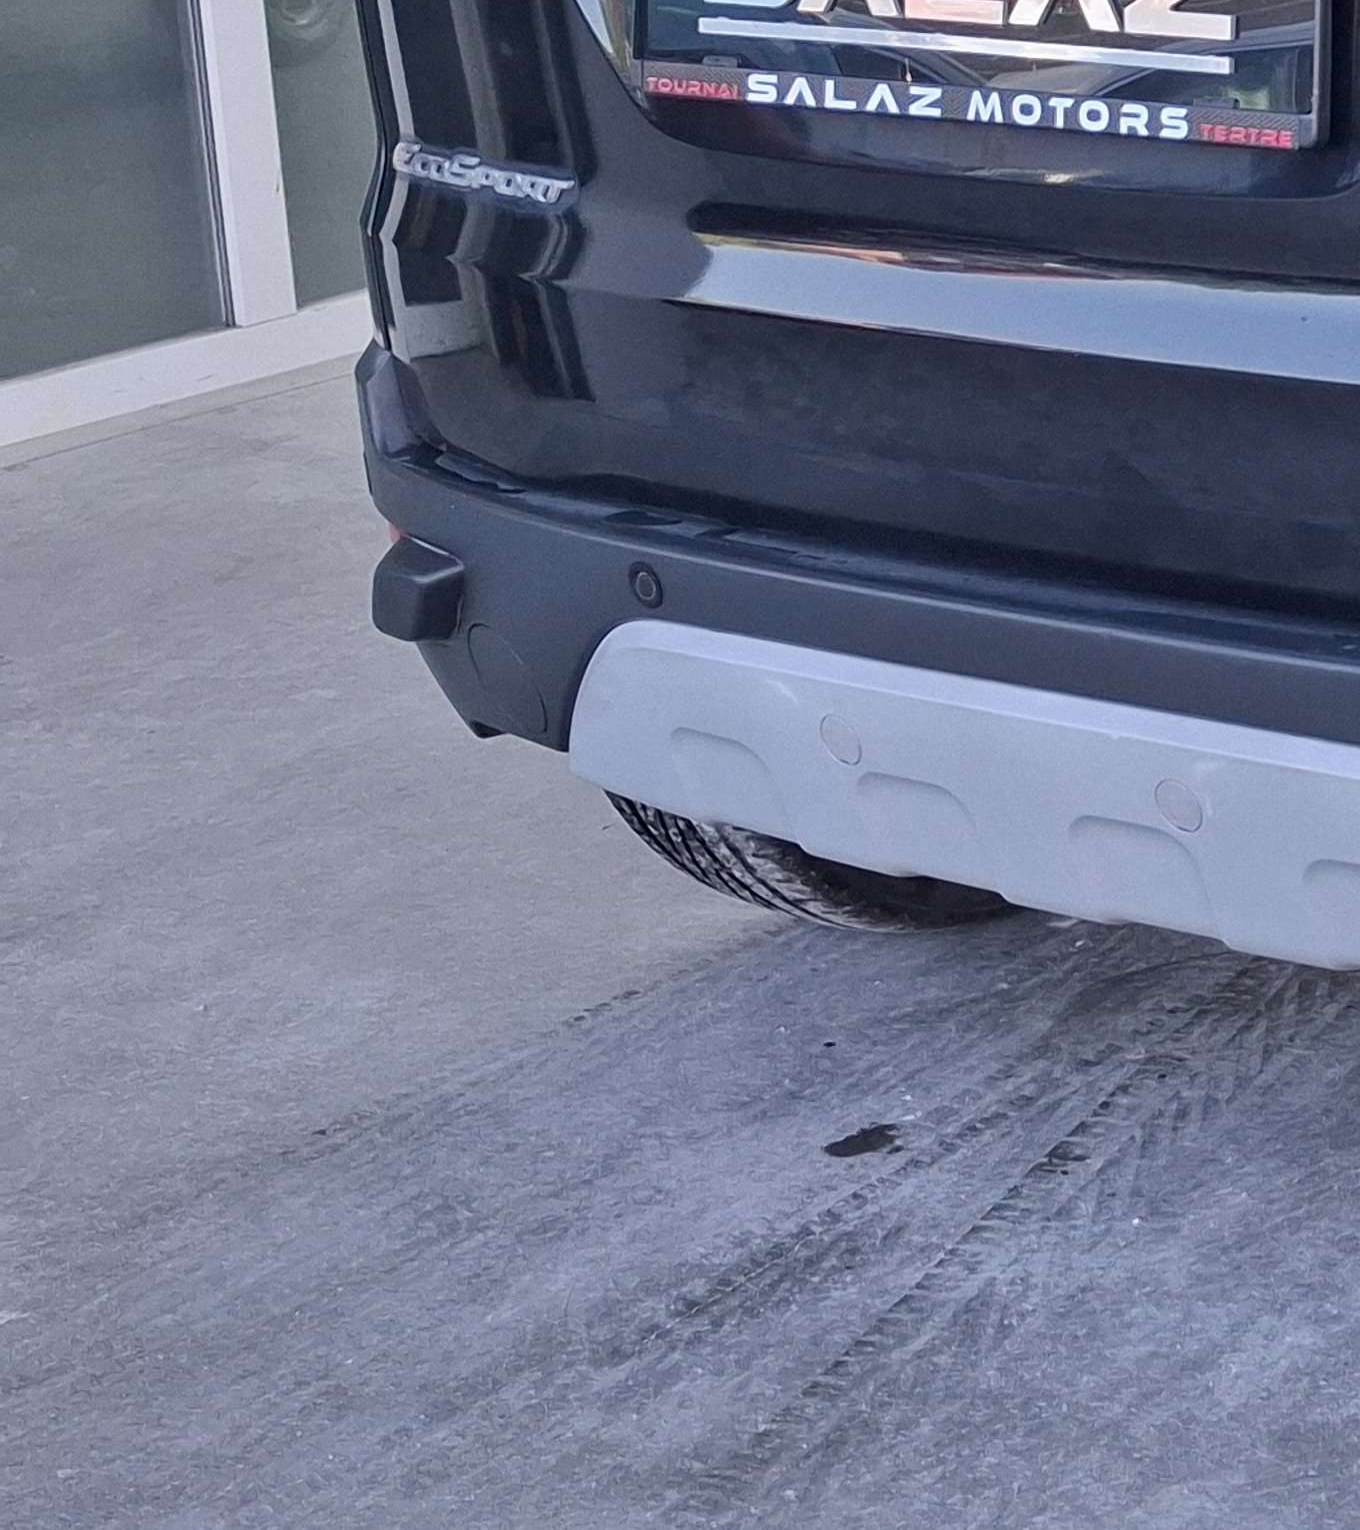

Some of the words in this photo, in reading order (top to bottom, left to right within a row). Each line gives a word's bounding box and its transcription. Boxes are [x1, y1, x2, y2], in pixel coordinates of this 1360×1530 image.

[646, 76, 739, 100] TOURNAI
[745, 72, 943, 118] SALAZ
[965, 89, 1189, 140] MOTORS
[1200, 122, 1294, 150] TERTRE
